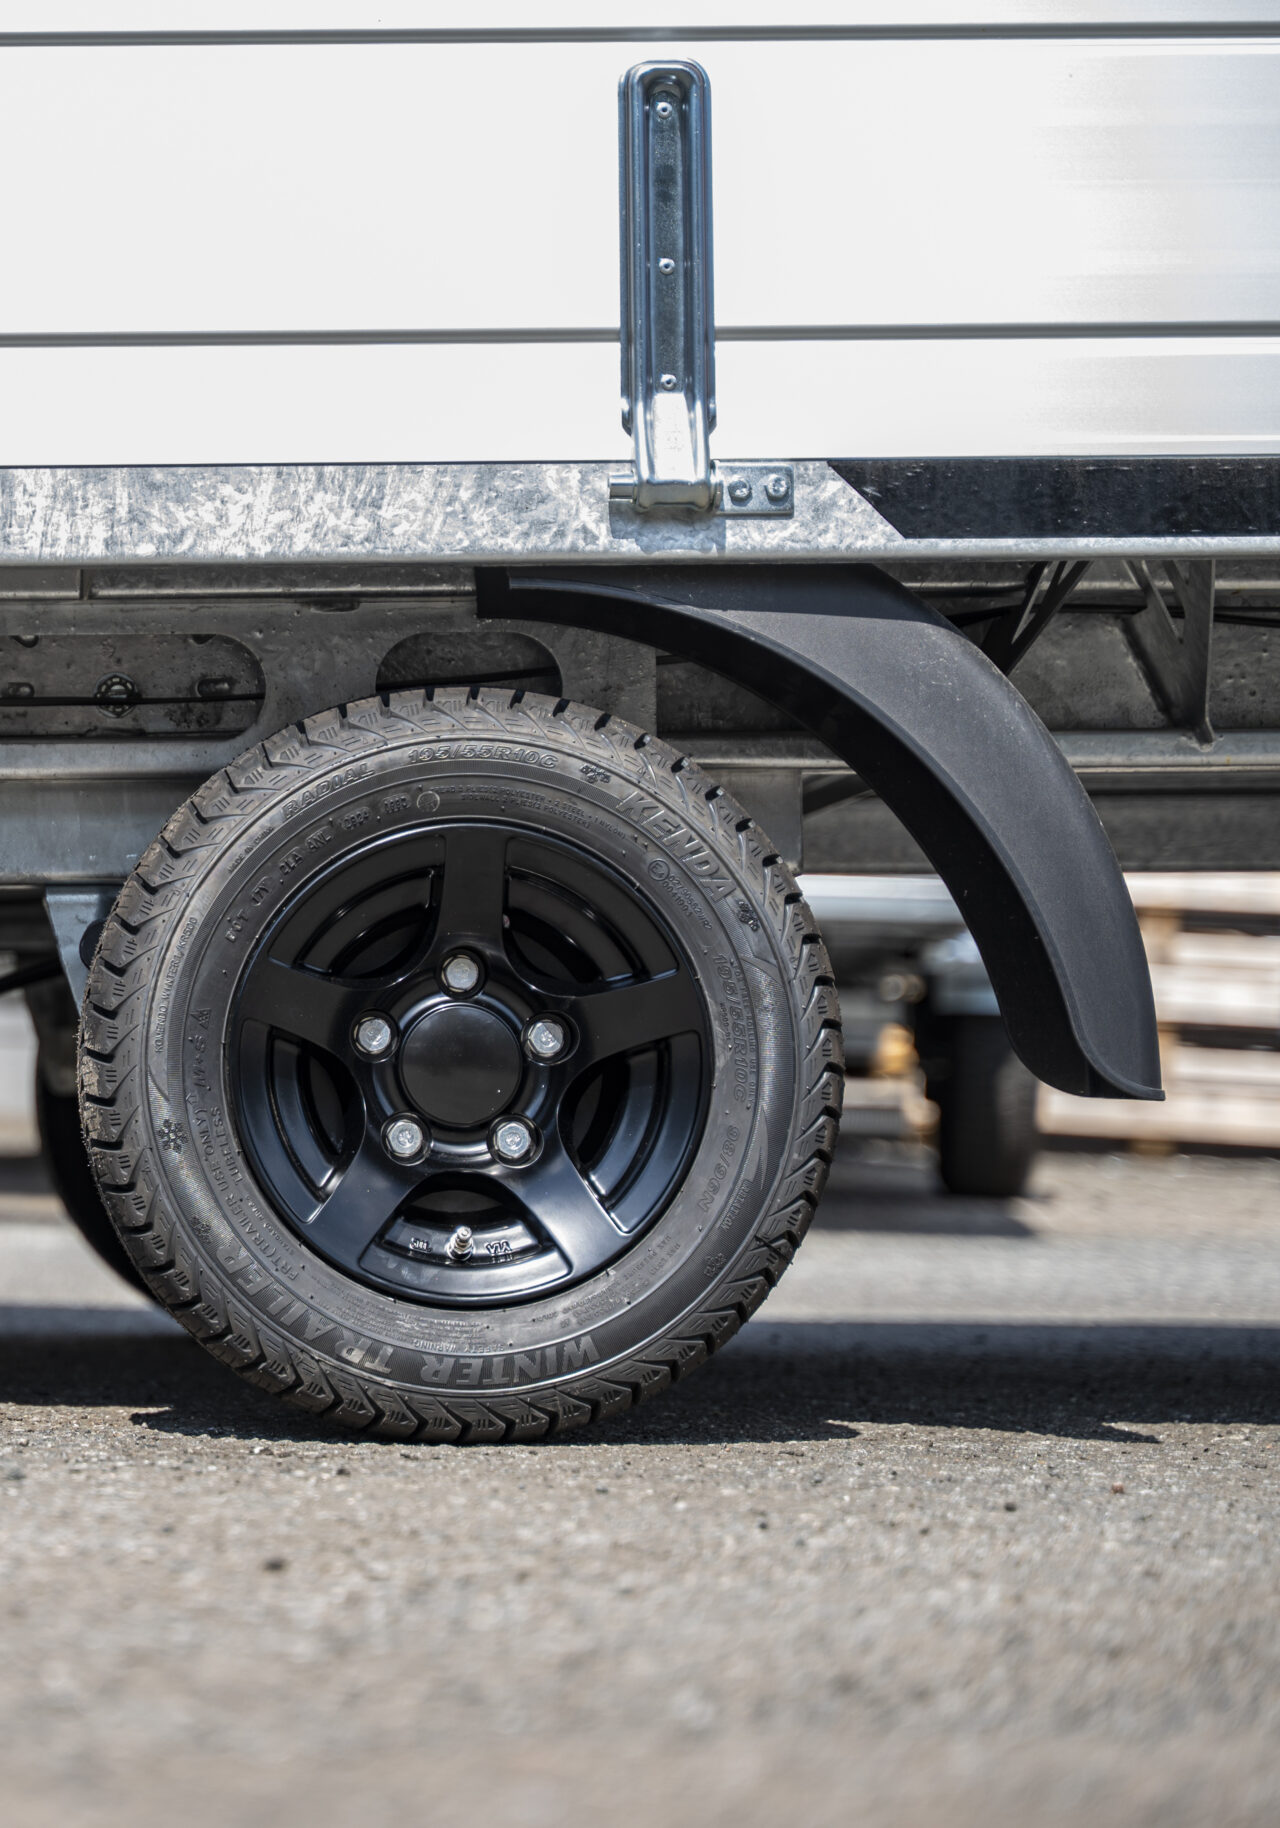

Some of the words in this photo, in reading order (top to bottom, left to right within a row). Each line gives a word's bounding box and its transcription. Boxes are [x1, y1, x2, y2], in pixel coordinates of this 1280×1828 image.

[406, 744, 559, 770] 195/55R10C
[278, 759, 375, 820] RADIAL
[614, 784, 737, 905] KENDA
[221, 907, 252, 944] DOT
[152, 1004, 169, 1053] KOMENDO
[711, 950, 747, 1103] 195/55R10C
[192, 1107, 219, 1157] ONLY)
[208, 1105, 246, 1186] TUBELESS
[207, 1159, 231, 1192] USE
[694, 1123, 742, 1214] 98/96N
[211, 1235, 397, 1375] TRAILER
[416, 1332, 601, 1386] WINTER
